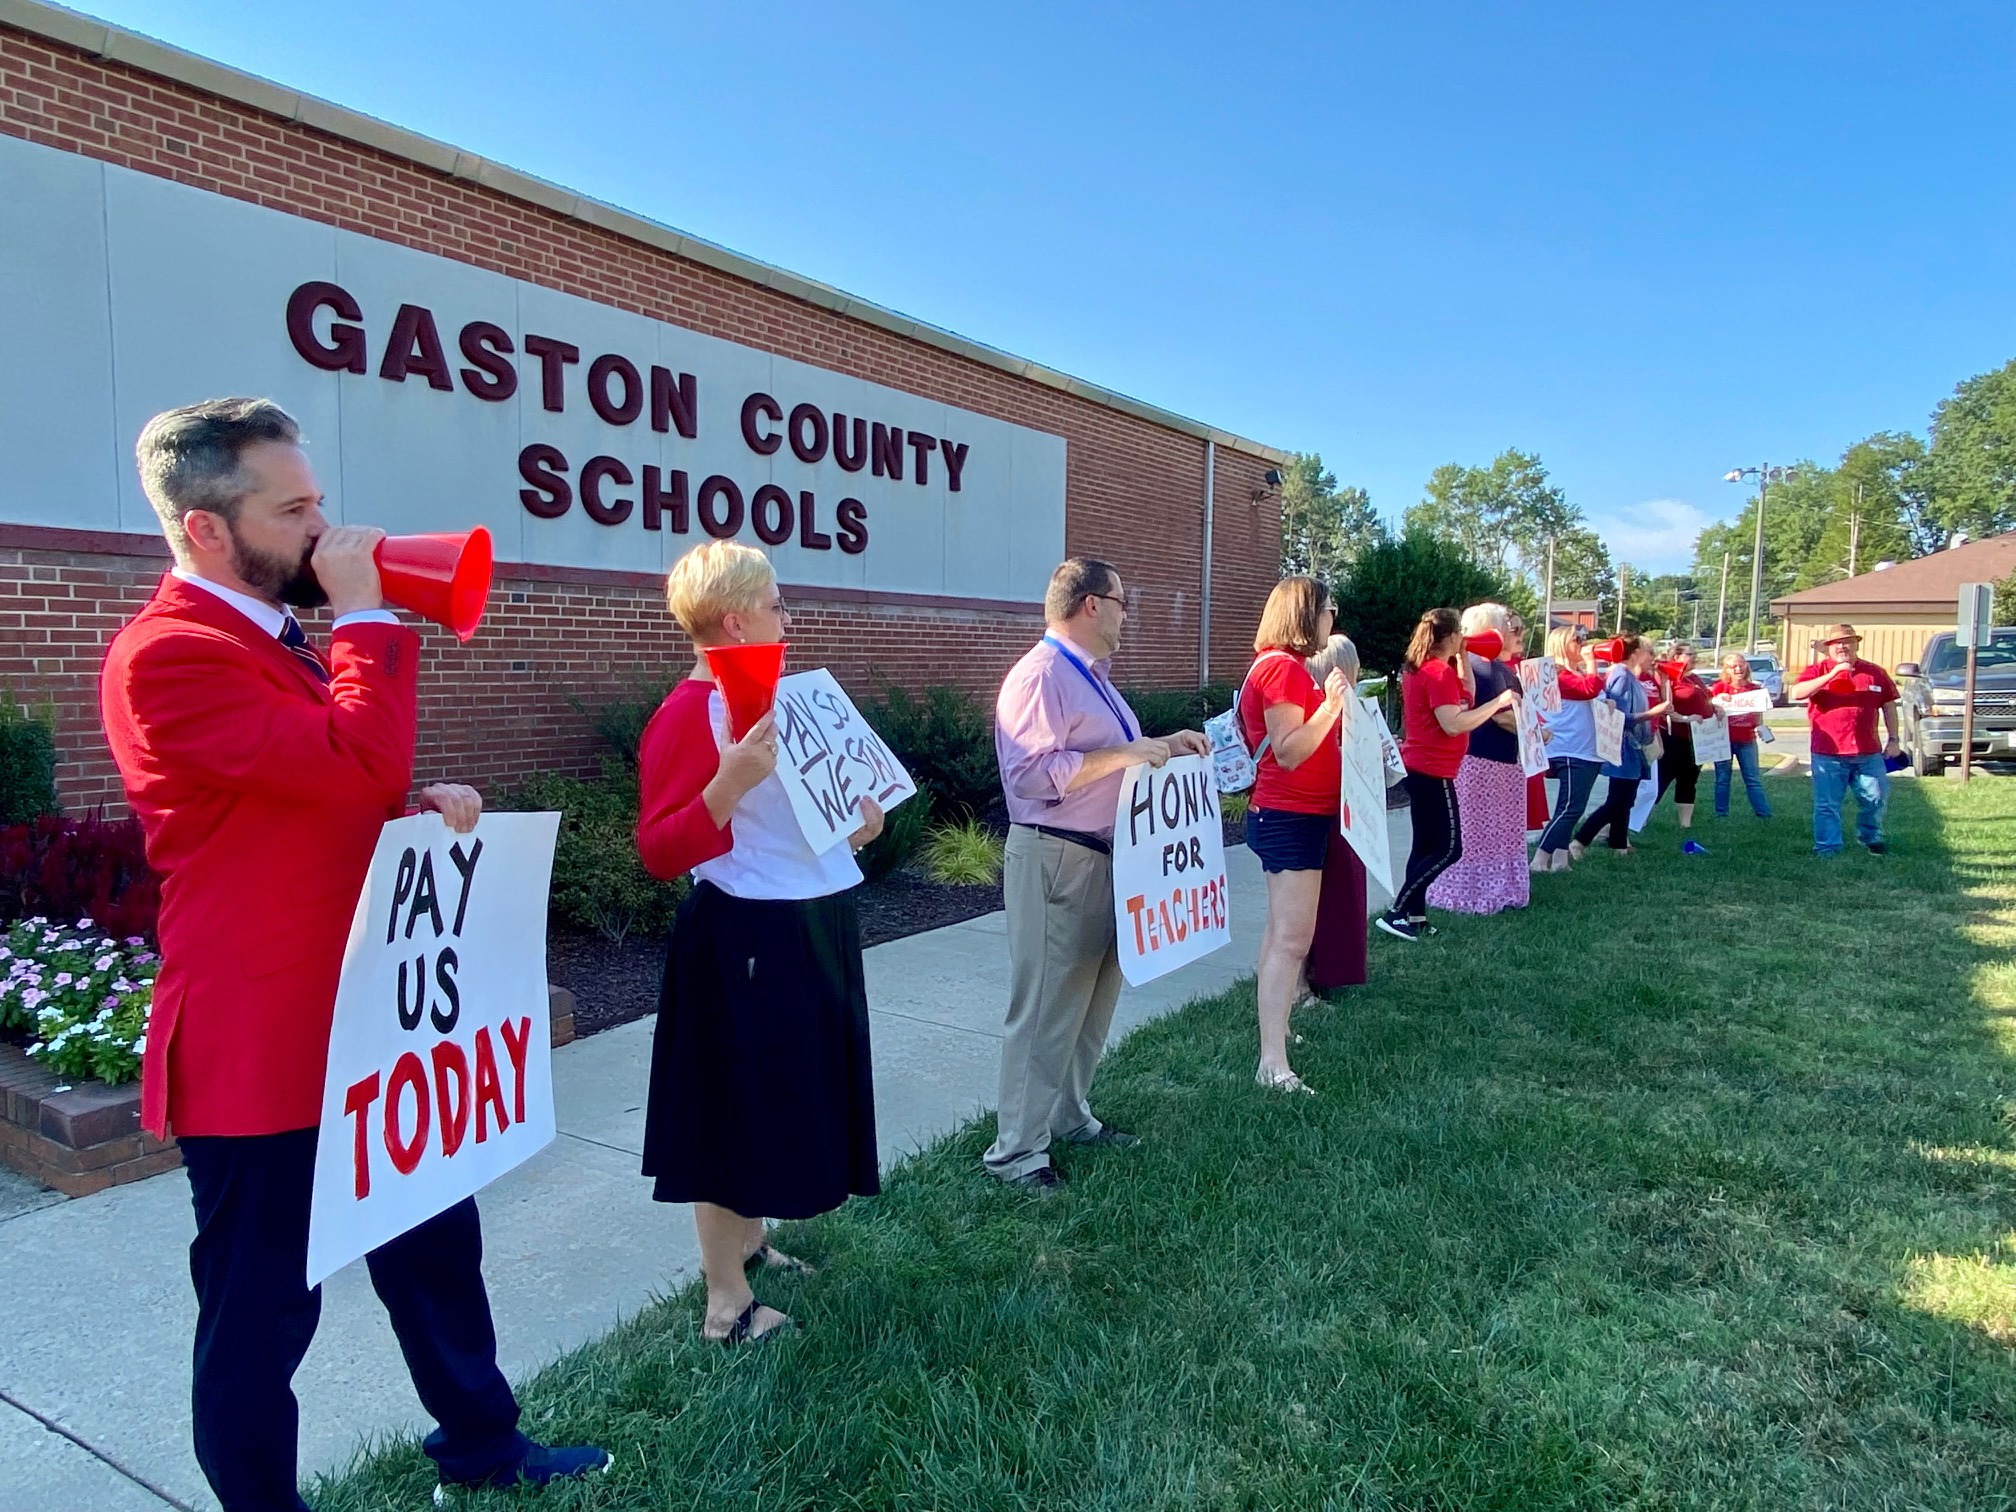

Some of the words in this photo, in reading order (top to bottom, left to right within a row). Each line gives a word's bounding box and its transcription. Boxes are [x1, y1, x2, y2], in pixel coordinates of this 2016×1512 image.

[286, 280, 697, 438] GASTON
[741, 392, 969, 491] COUNTY
[518, 443, 868, 554] SCHOOLS
[1524, 664, 1541, 693] PAY
[1543, 661, 1555, 685] SO
[1734, 698, 1756, 708] NCAE
[776, 691, 833, 766] PAY
[813, 688, 850, 730] SO
[801, 754, 860, 833] WE
[844, 732, 896, 791] STAY
[1130, 771, 1214, 847] HONK
[386, 837, 483, 945] PAY
[1163, 836, 1204, 876] FOR
[1126, 873, 1226, 956] TEACHERS
[397, 946, 459, 1034] US
[344, 1016, 531, 1201] TODAY
